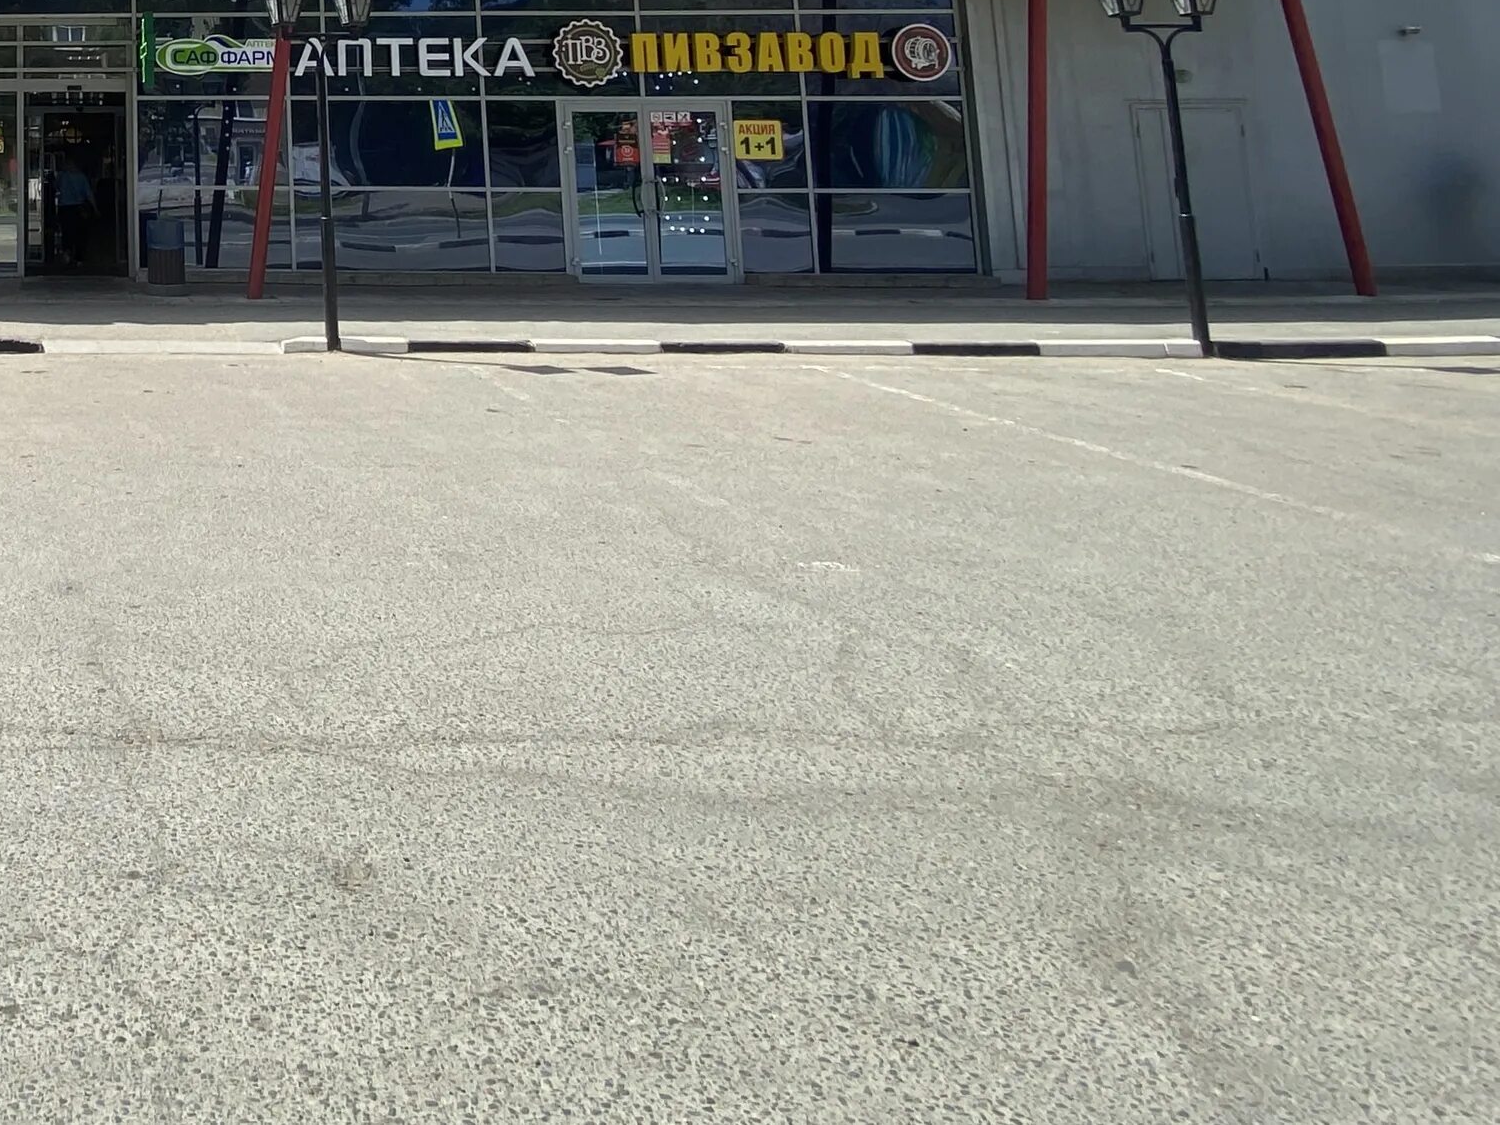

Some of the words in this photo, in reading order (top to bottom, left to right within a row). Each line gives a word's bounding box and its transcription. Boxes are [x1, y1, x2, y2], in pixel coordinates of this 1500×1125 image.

[294, 37, 536, 77] АПТЕКА
[629, 31, 885, 79] ПИВЗАВОД
[738, 124, 776, 135] АКЦИЯ
